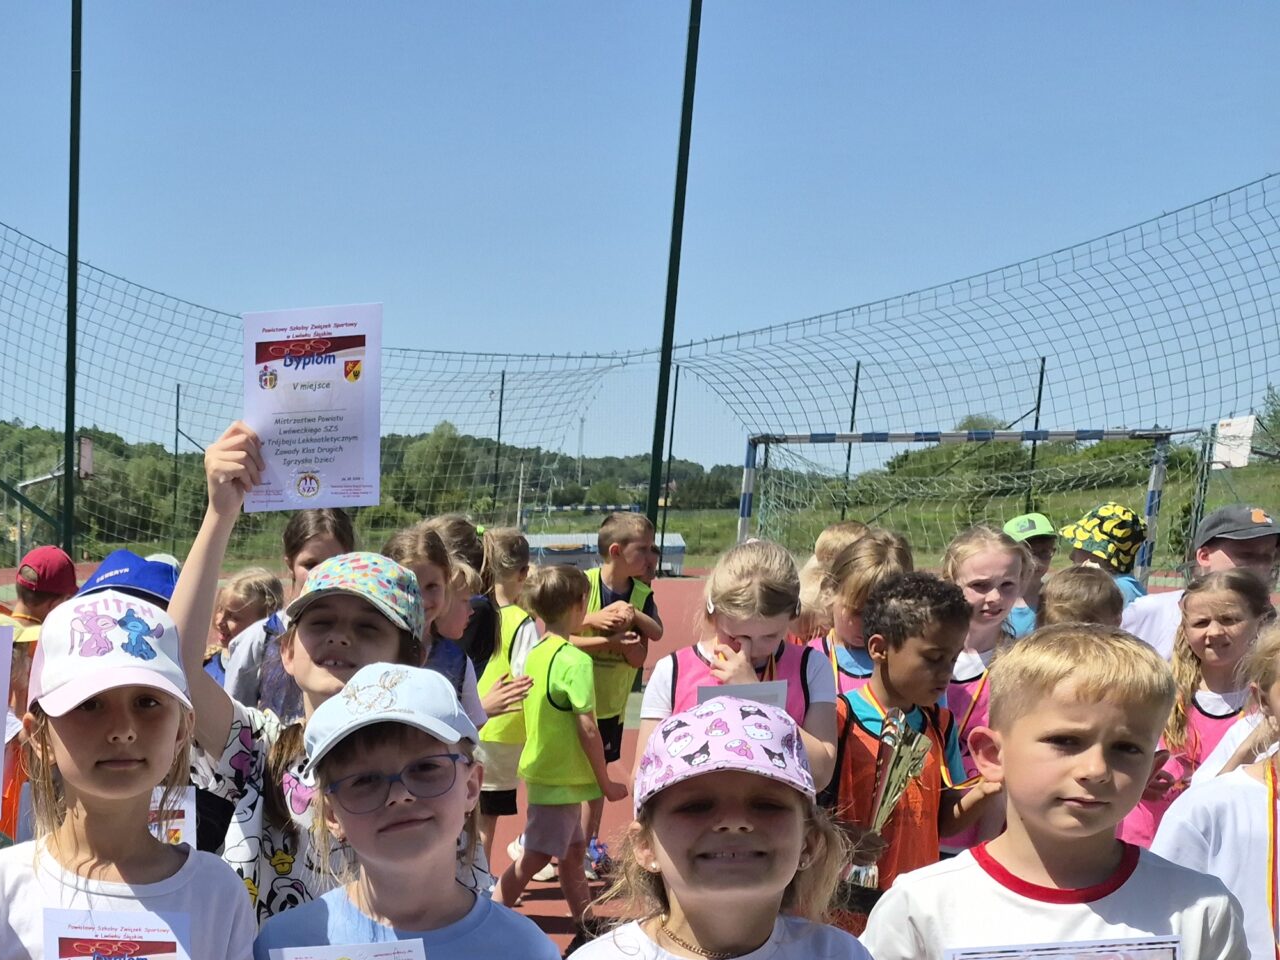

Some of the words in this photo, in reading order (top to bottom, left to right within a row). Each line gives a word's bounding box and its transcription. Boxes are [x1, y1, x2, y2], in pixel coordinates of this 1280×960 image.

[284, 353, 335, 370] Dyplom
[300, 382, 330, 391] miejsce
[279, 427, 321, 435] Lwóweckiego
[275, 448, 300, 456] Zawody
[317, 446, 343, 454] Drugich
[283, 458, 312, 466] Igrzyska
[314, 456, 335, 464] Dzieci
[73, 598, 154, 618] STITCH
